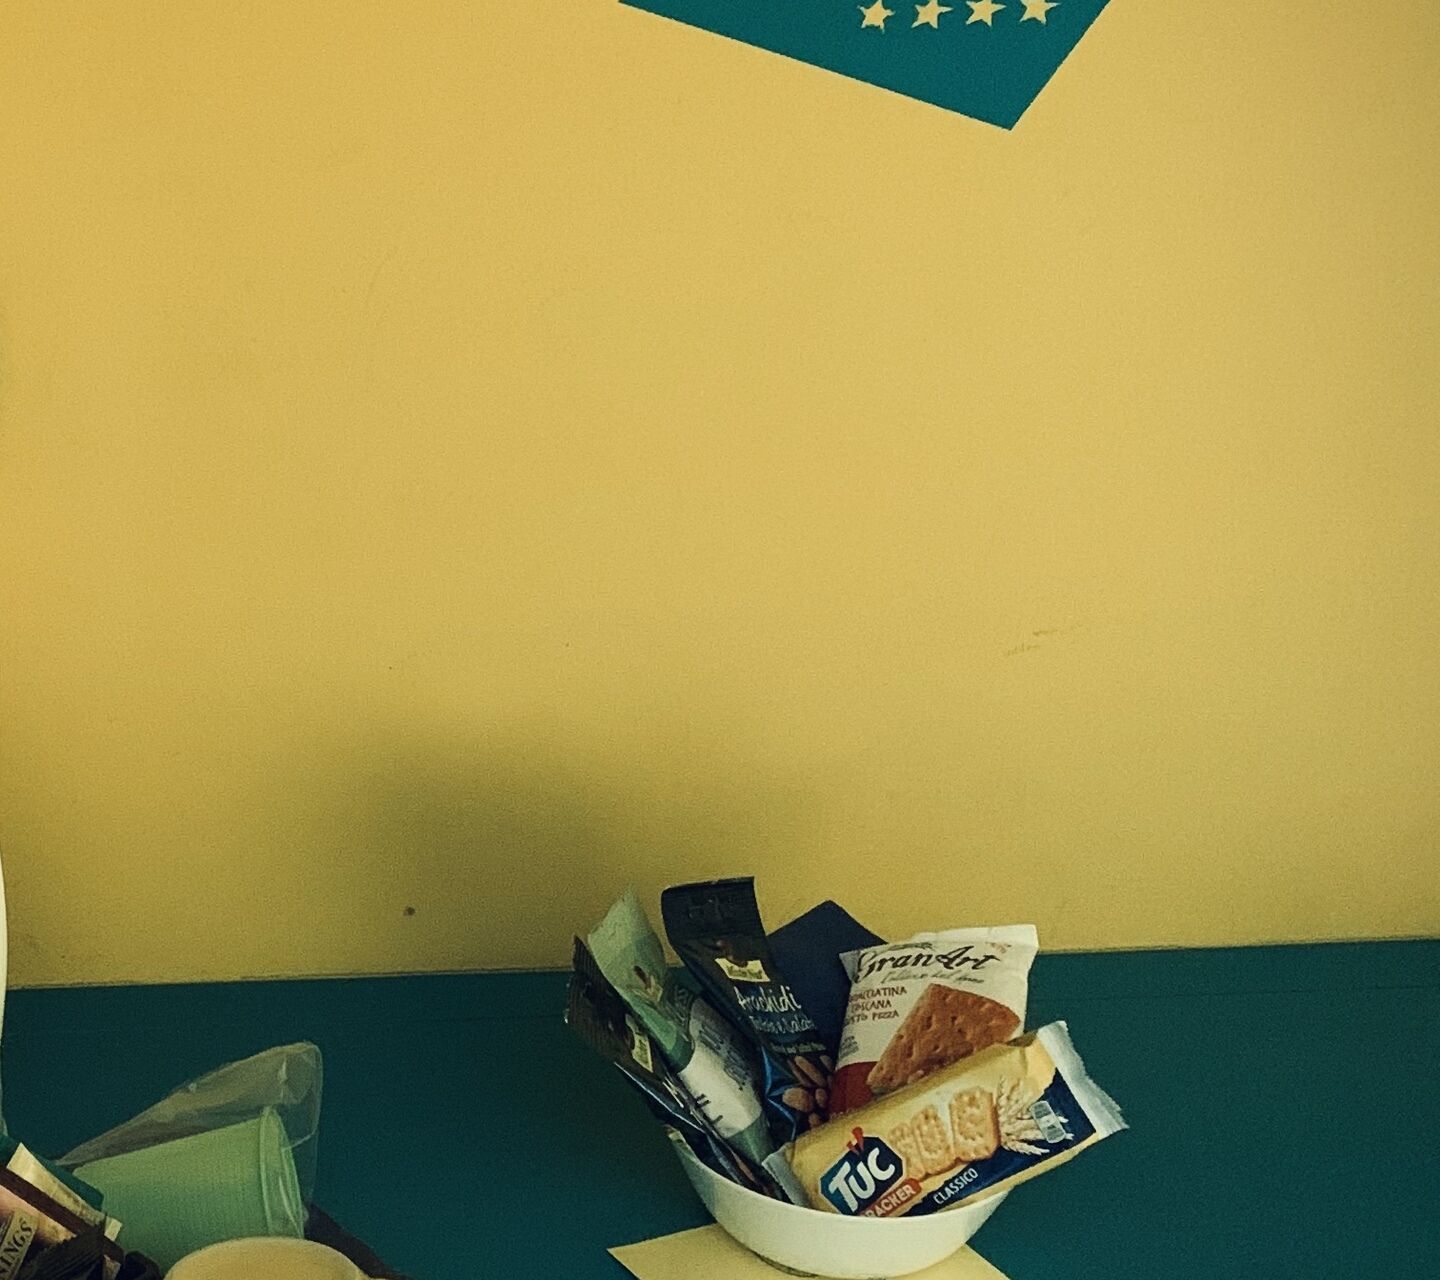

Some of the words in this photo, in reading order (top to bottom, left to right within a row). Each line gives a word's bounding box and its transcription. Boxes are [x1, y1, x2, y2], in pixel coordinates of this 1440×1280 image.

[871, 1009, 900, 1022] PIZZA
[828, 1147, 896, 1212] TUC
[933, 1167, 979, 1205] CLASSICO
[862, 1184, 916, 1217] RACKER
